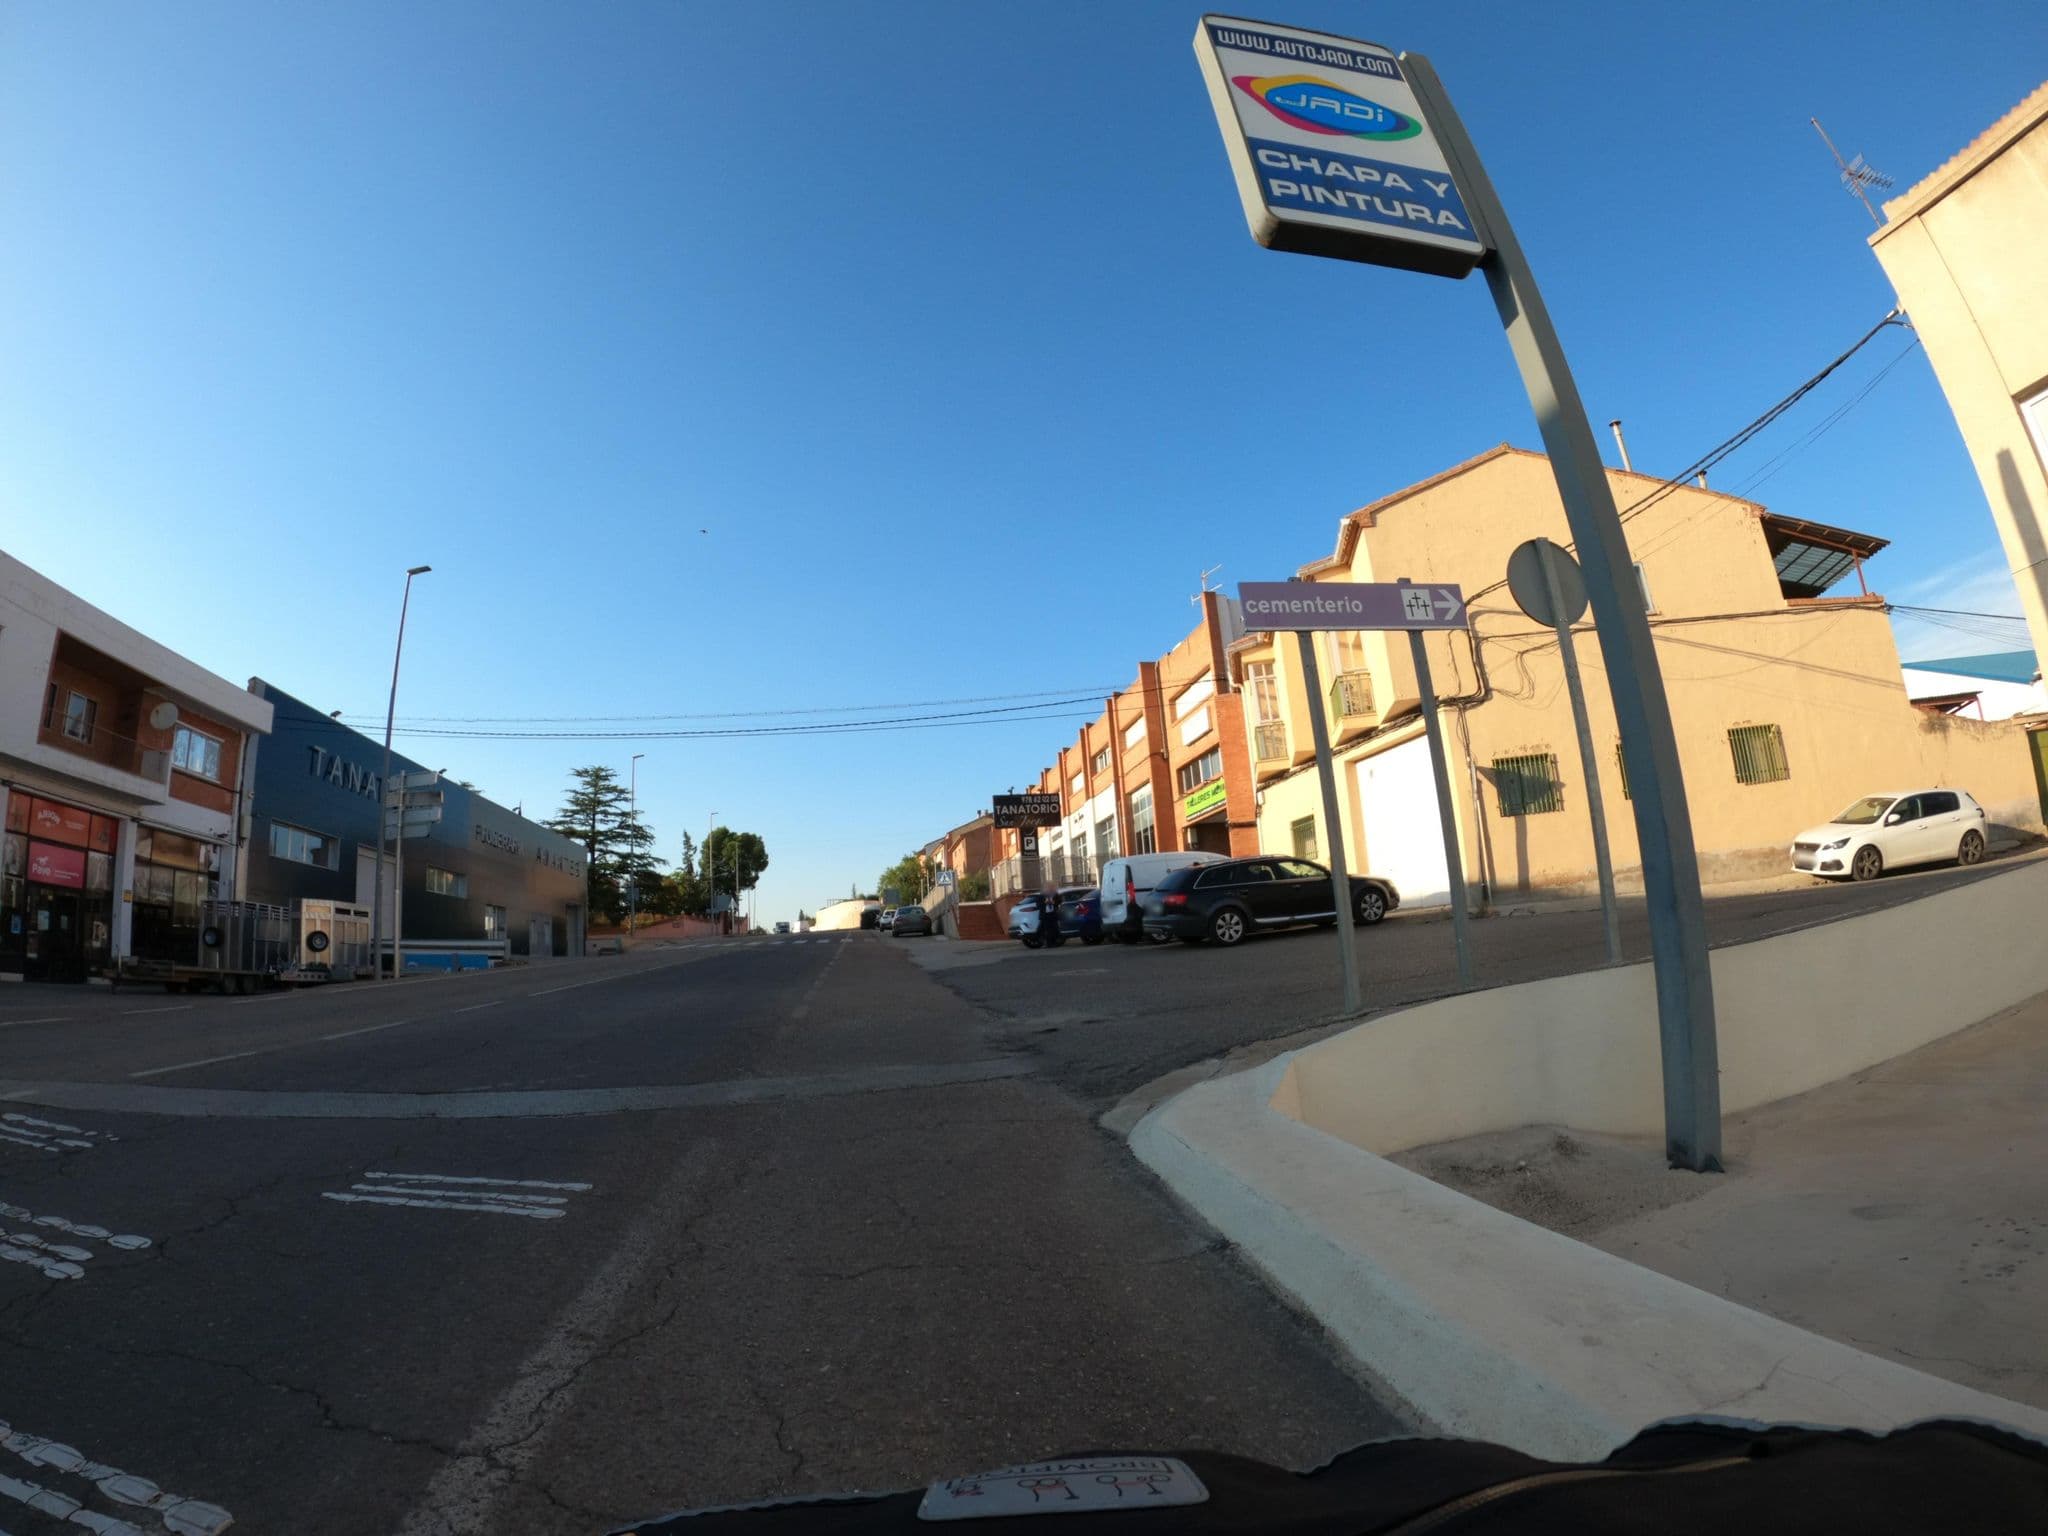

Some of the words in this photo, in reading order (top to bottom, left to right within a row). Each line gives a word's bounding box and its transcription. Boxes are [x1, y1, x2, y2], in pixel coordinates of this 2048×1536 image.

[1217, 30, 1395, 75] WWW.AUTOJADI.COM
[1257, 149, 1412, 192] CHAPA
[1422, 179, 1449, 198] Y
[1269, 179, 1465, 230] PINTURA
[1246, 596, 1363, 614] cementerio
[996, 804, 1059, 815] TANATORIO
